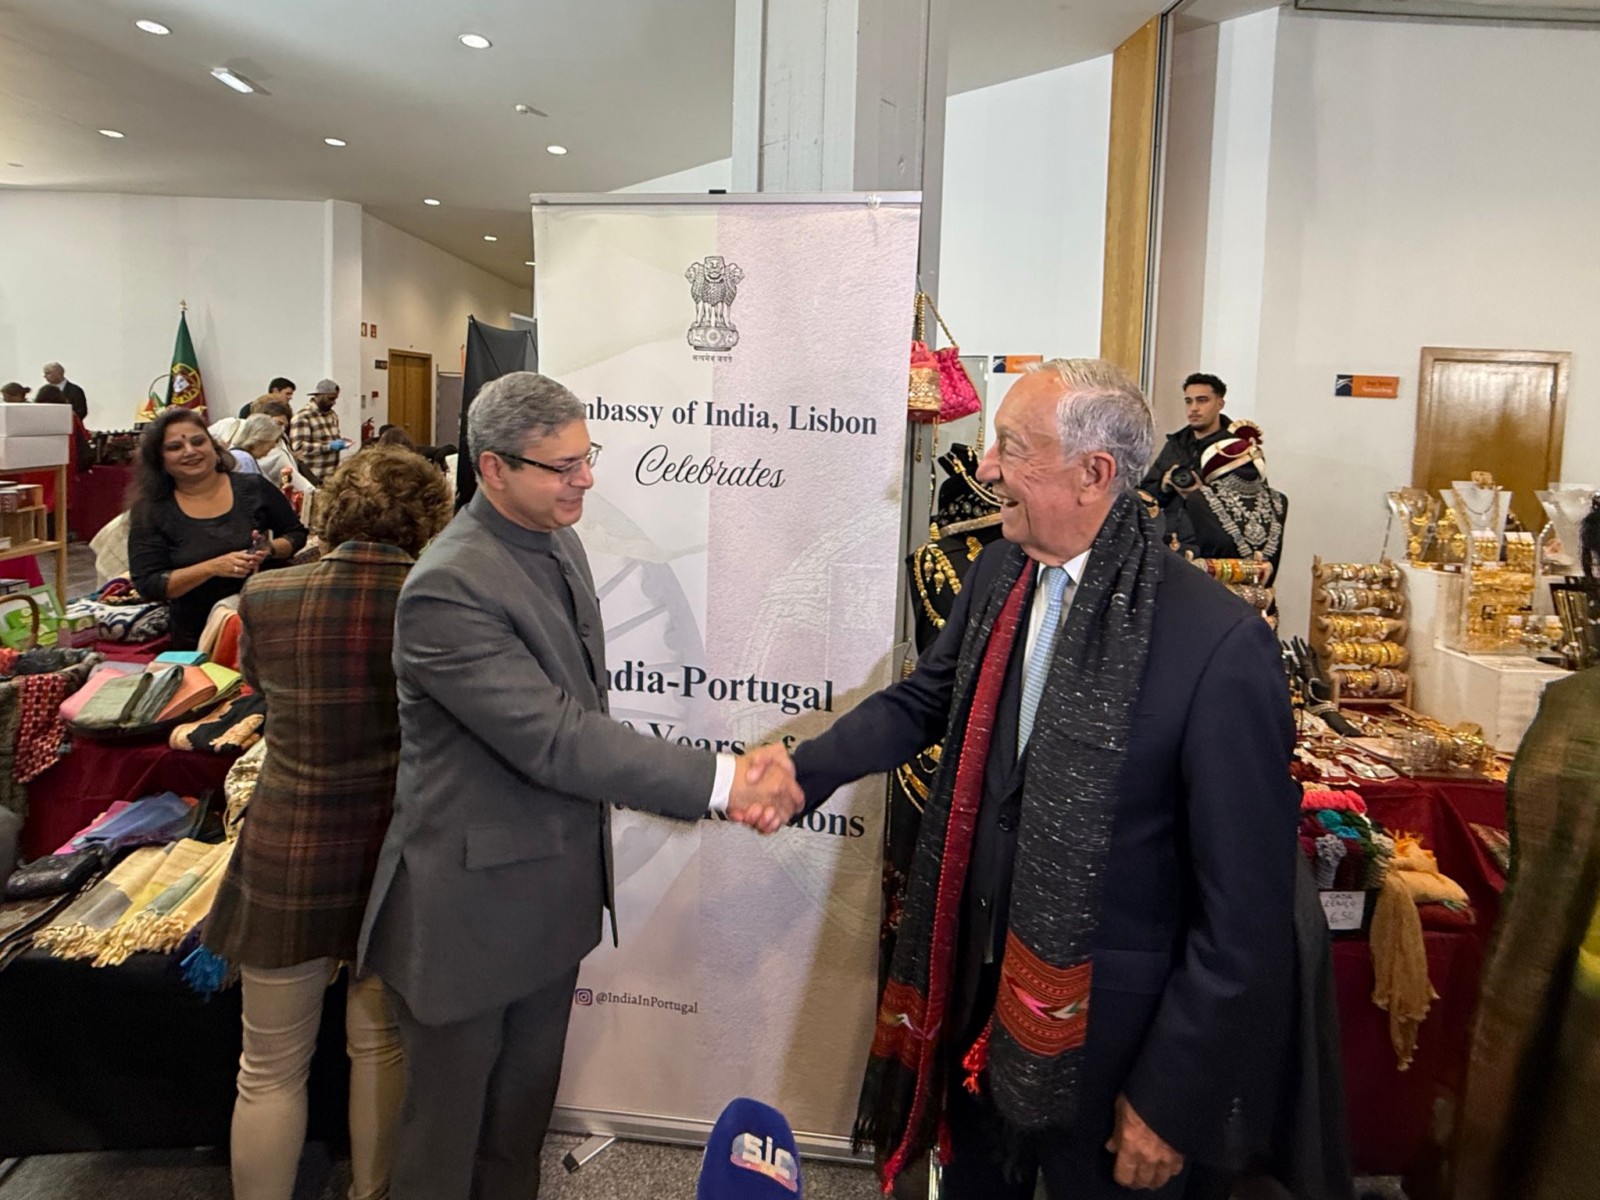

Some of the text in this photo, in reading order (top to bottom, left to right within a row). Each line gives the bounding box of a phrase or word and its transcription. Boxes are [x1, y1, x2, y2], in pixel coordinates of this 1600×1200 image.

[582, 396, 877, 435] mbassy of India, Lisbon
[635, 444, 786, 488] Celebrates
[606, 660, 834, 715] dia-Portugal
[595, 992, 699, 1015] @IndiaInPortugal
